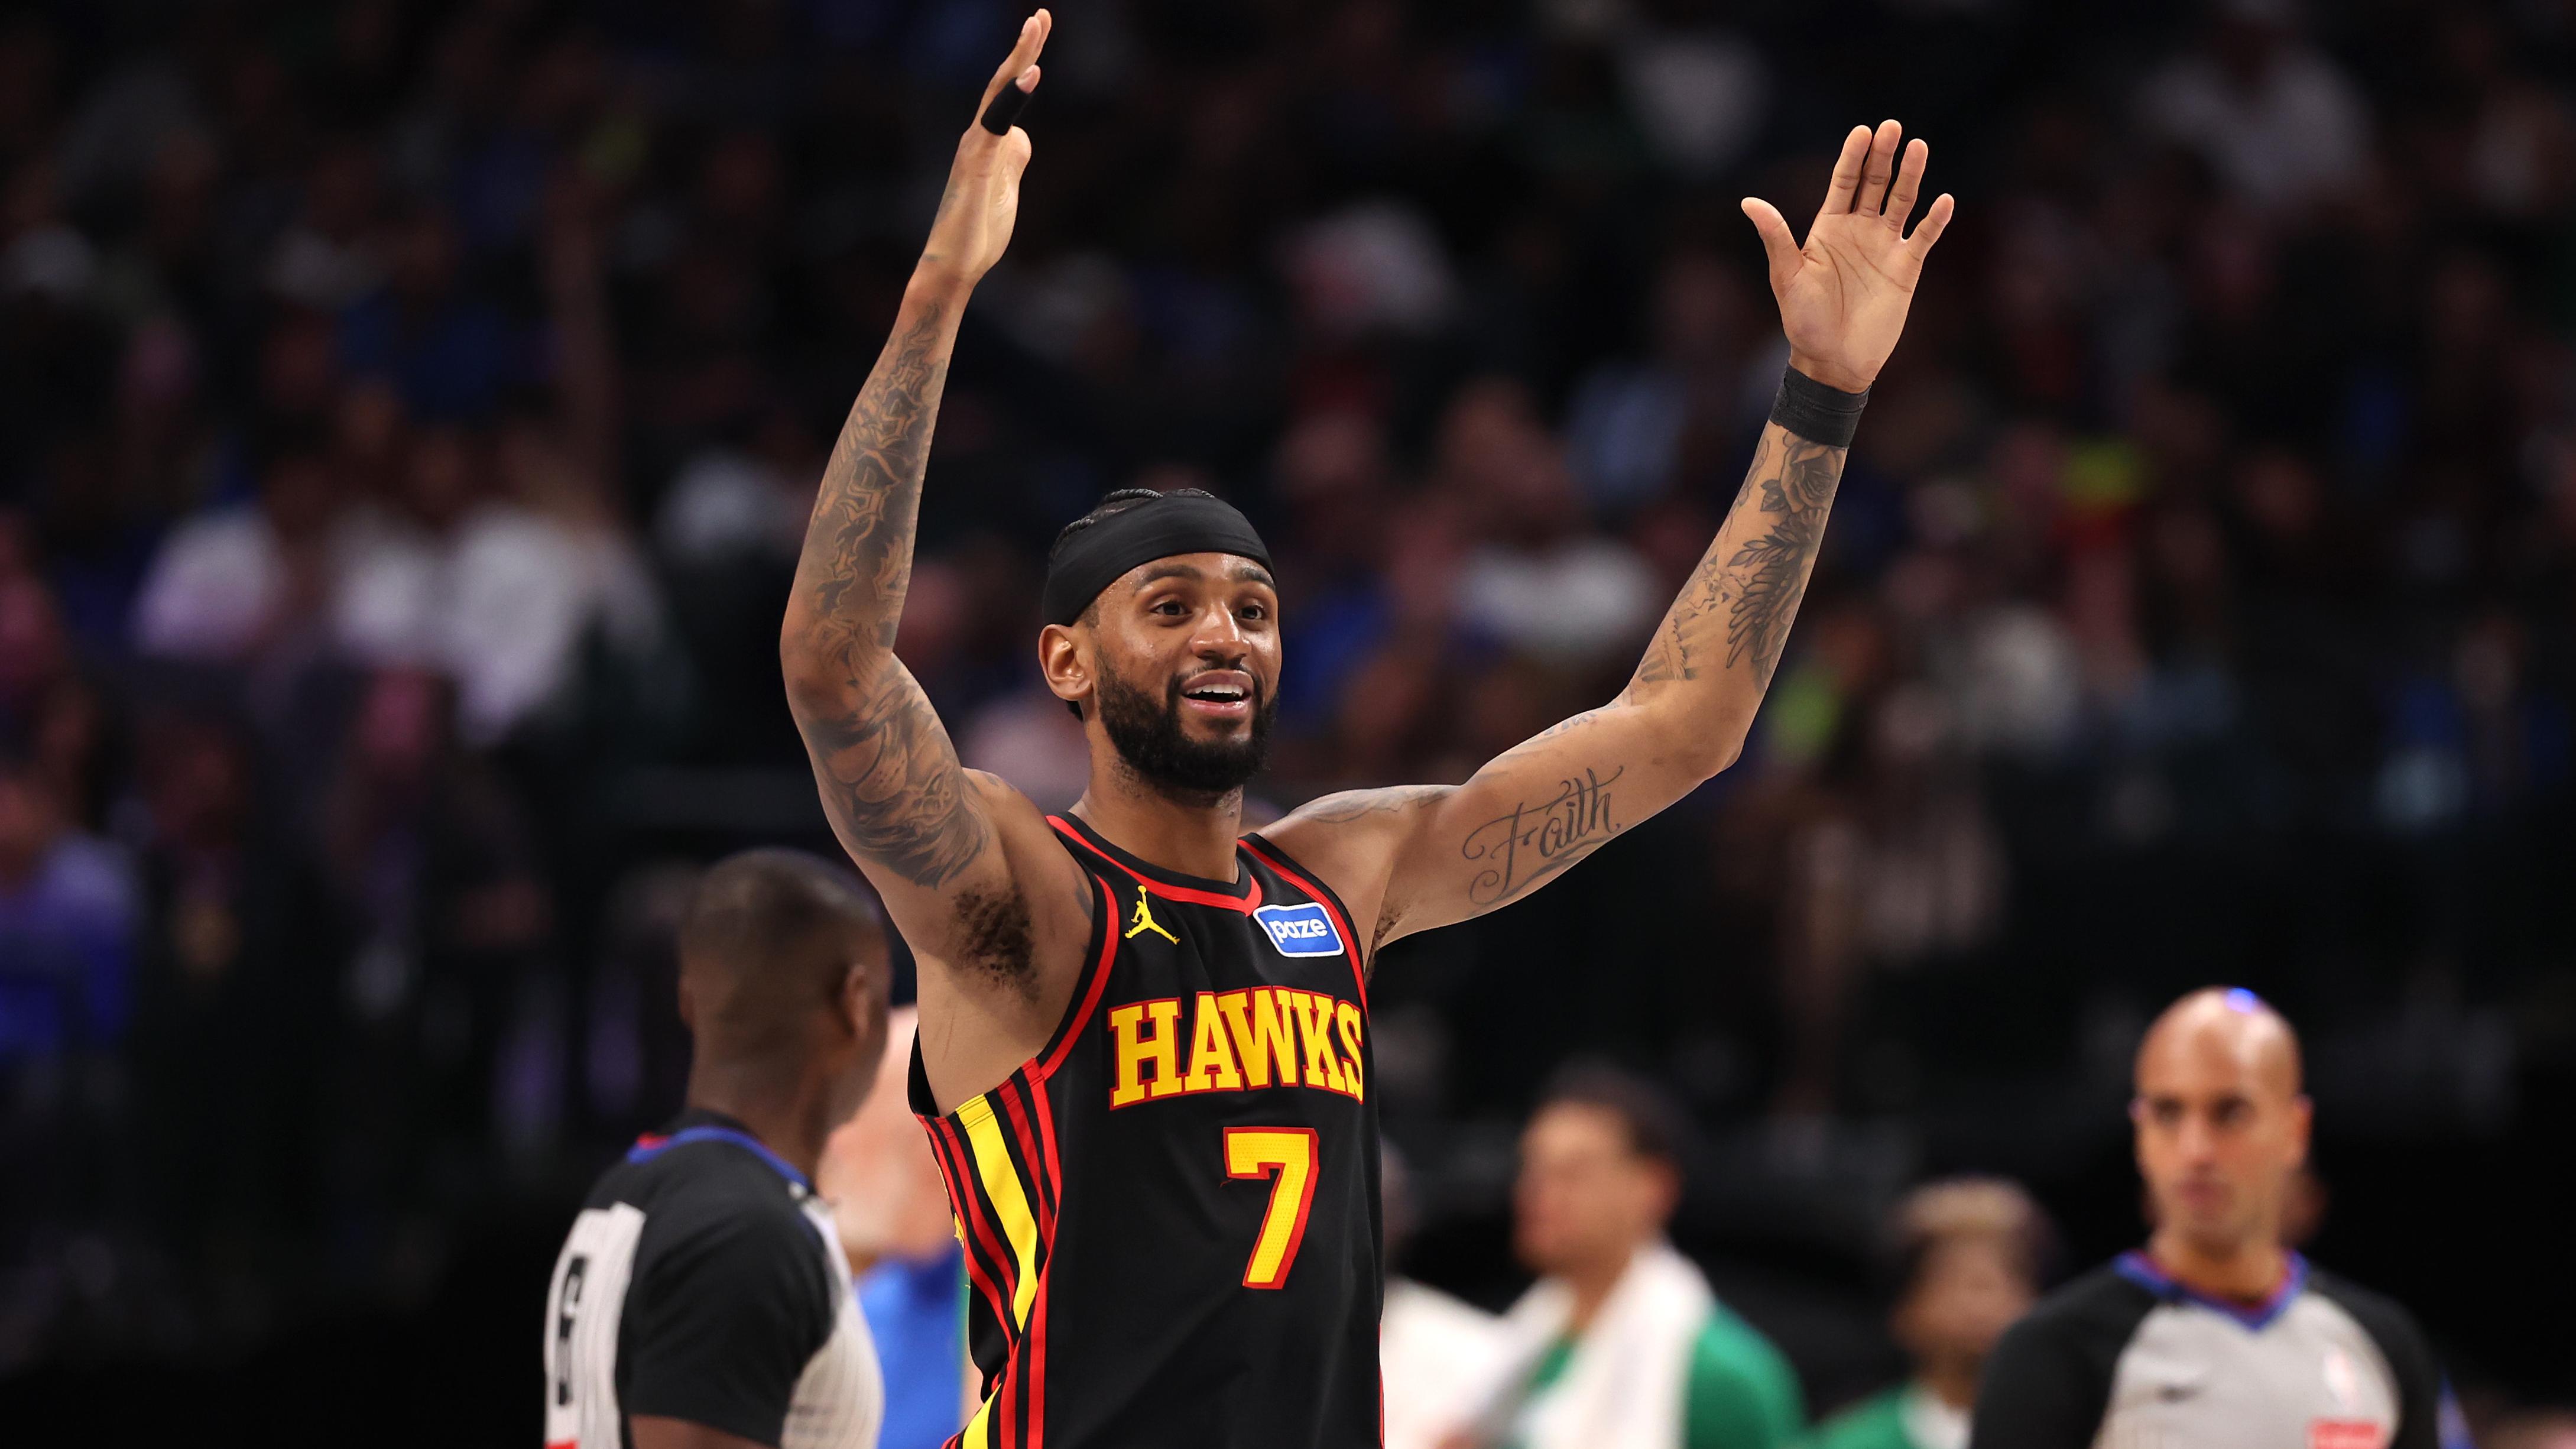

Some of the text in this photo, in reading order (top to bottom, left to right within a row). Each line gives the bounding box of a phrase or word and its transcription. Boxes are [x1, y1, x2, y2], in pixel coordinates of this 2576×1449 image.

[1268, 919, 1328, 944] paze
[1108, 985, 1363, 1110] HAWKS
[1223, 1126, 1319, 1289] 7
